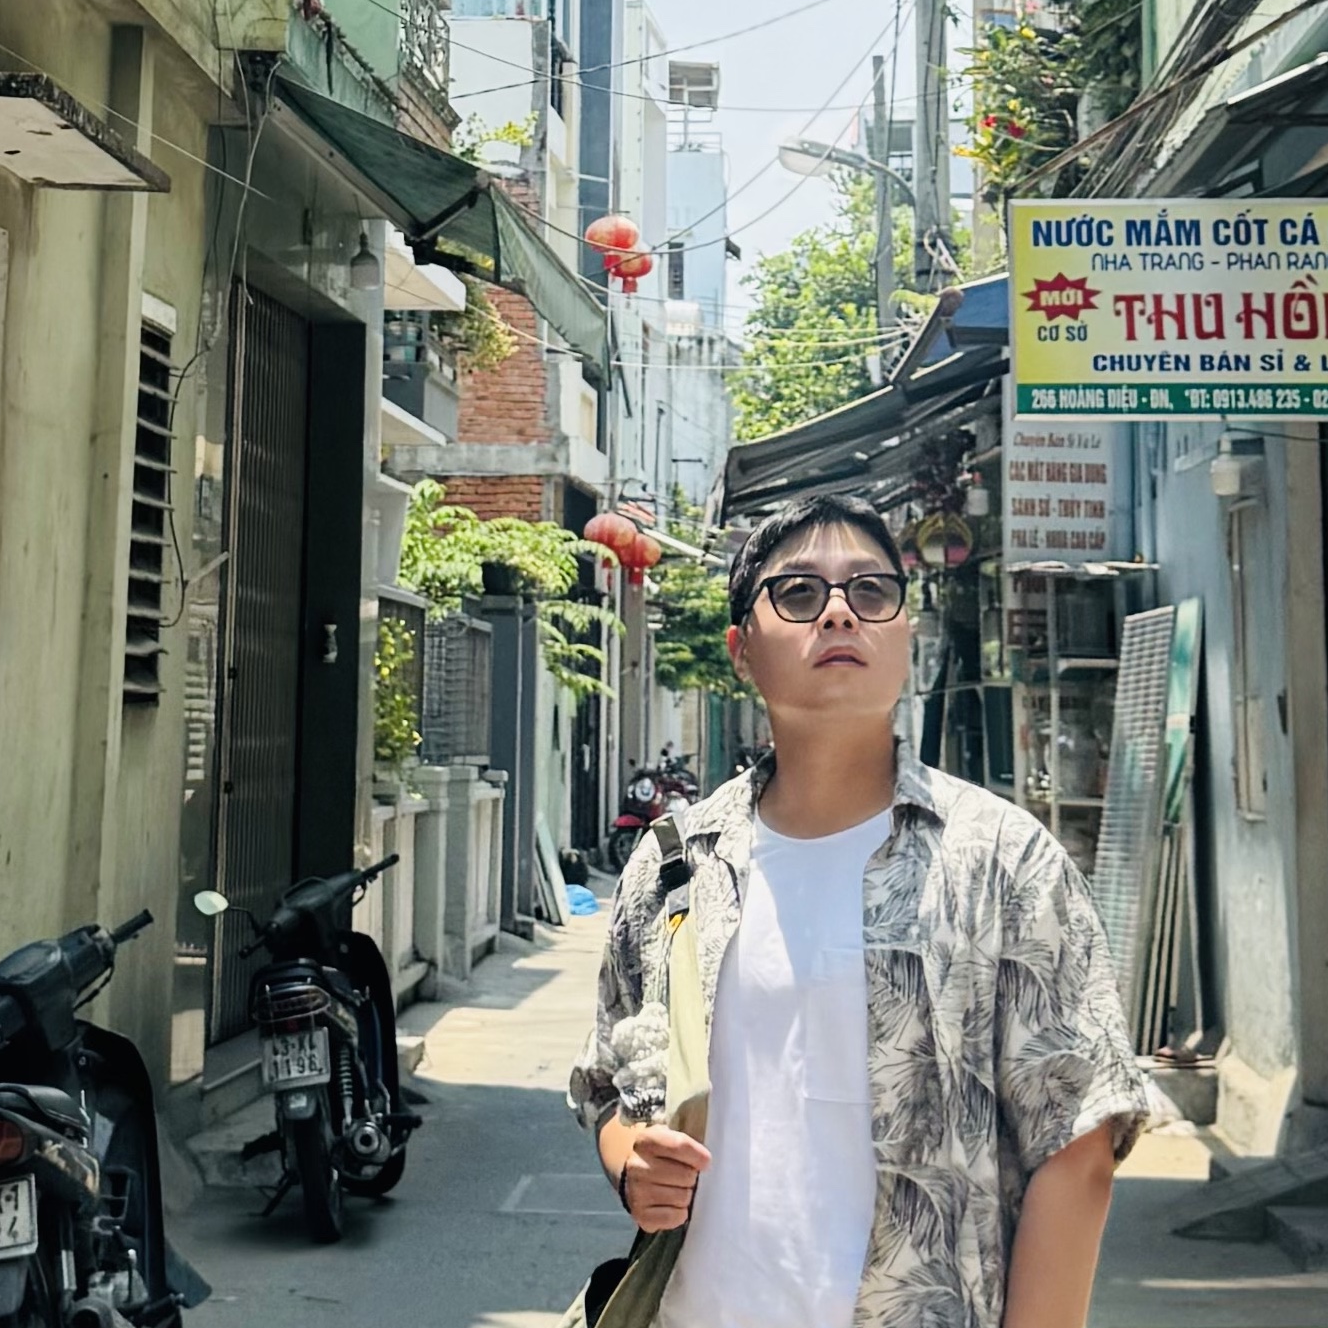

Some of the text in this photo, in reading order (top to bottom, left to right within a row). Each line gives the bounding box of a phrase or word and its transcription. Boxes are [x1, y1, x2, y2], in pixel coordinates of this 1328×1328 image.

[1033, 214, 1114, 247] NƯỚC
[1126, 208, 1201, 247] MẮM
[1213, 209, 1268, 246] CỐT
[1279, 212, 1320, 246] CÁ
[1092, 252, 1132, 271] NHA
[1139, 252, 1204, 271] TRANG
[1227, 252, 1280, 271] PHAN
[1039, 287, 1083, 307] MỚI
[1113, 292, 1225, 341] THU
[1037, 320, 1088, 342] CƠ SỞ
[1092, 351, 1191, 372] CHUYÊN
[1200, 350, 1251, 372] BÁN
[1260, 348, 1284, 372] SỈ
[1293, 354, 1312, 372] &
[1059, 384, 1105, 409] HOÀNG
[1107, 384, 1138, 412] DIỆU
[1275, 388, 1301, 409] 235
